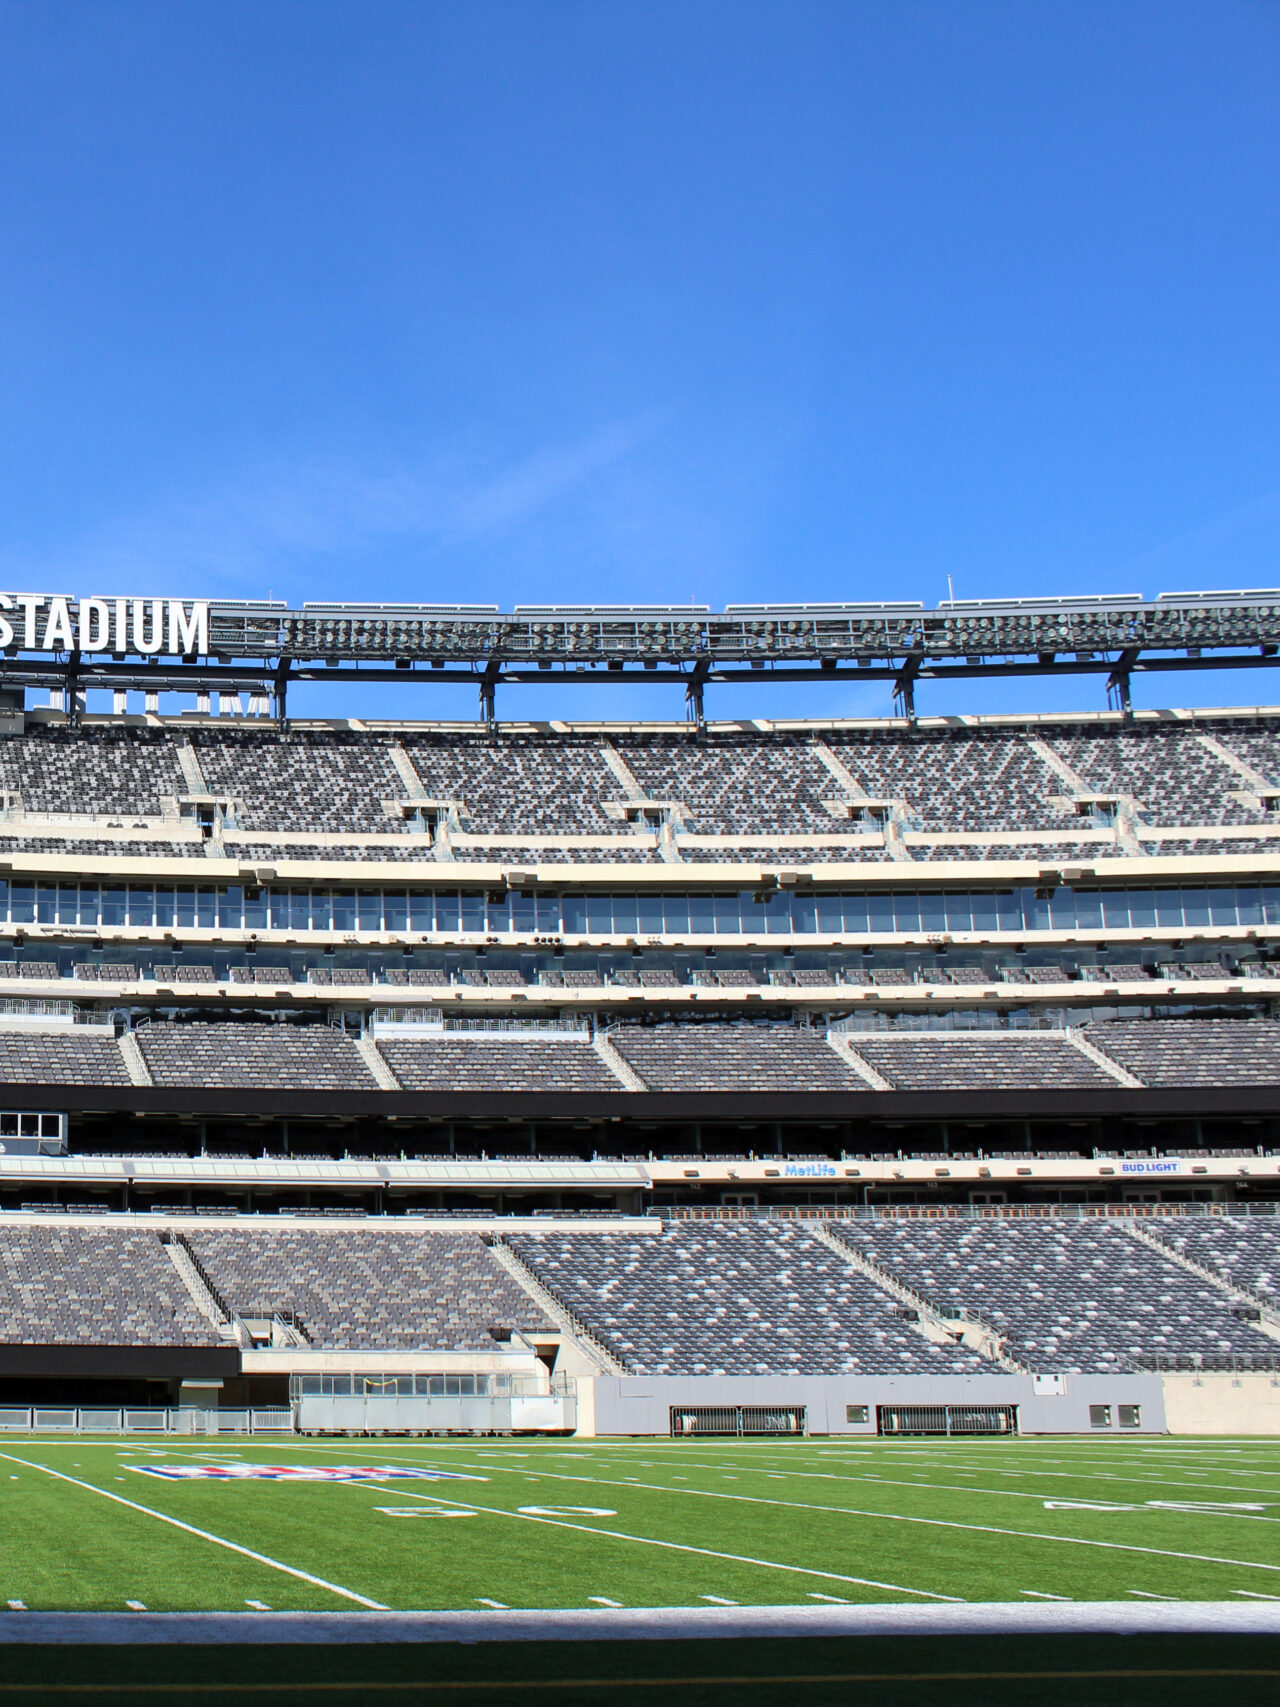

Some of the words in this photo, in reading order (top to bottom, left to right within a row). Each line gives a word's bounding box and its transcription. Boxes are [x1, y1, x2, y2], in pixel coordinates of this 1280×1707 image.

[784, 1164, 837, 1176] MetLife
[1122, 1163, 1145, 1172] BUD
[1146, 1163, 1178, 1171] LIGHT
